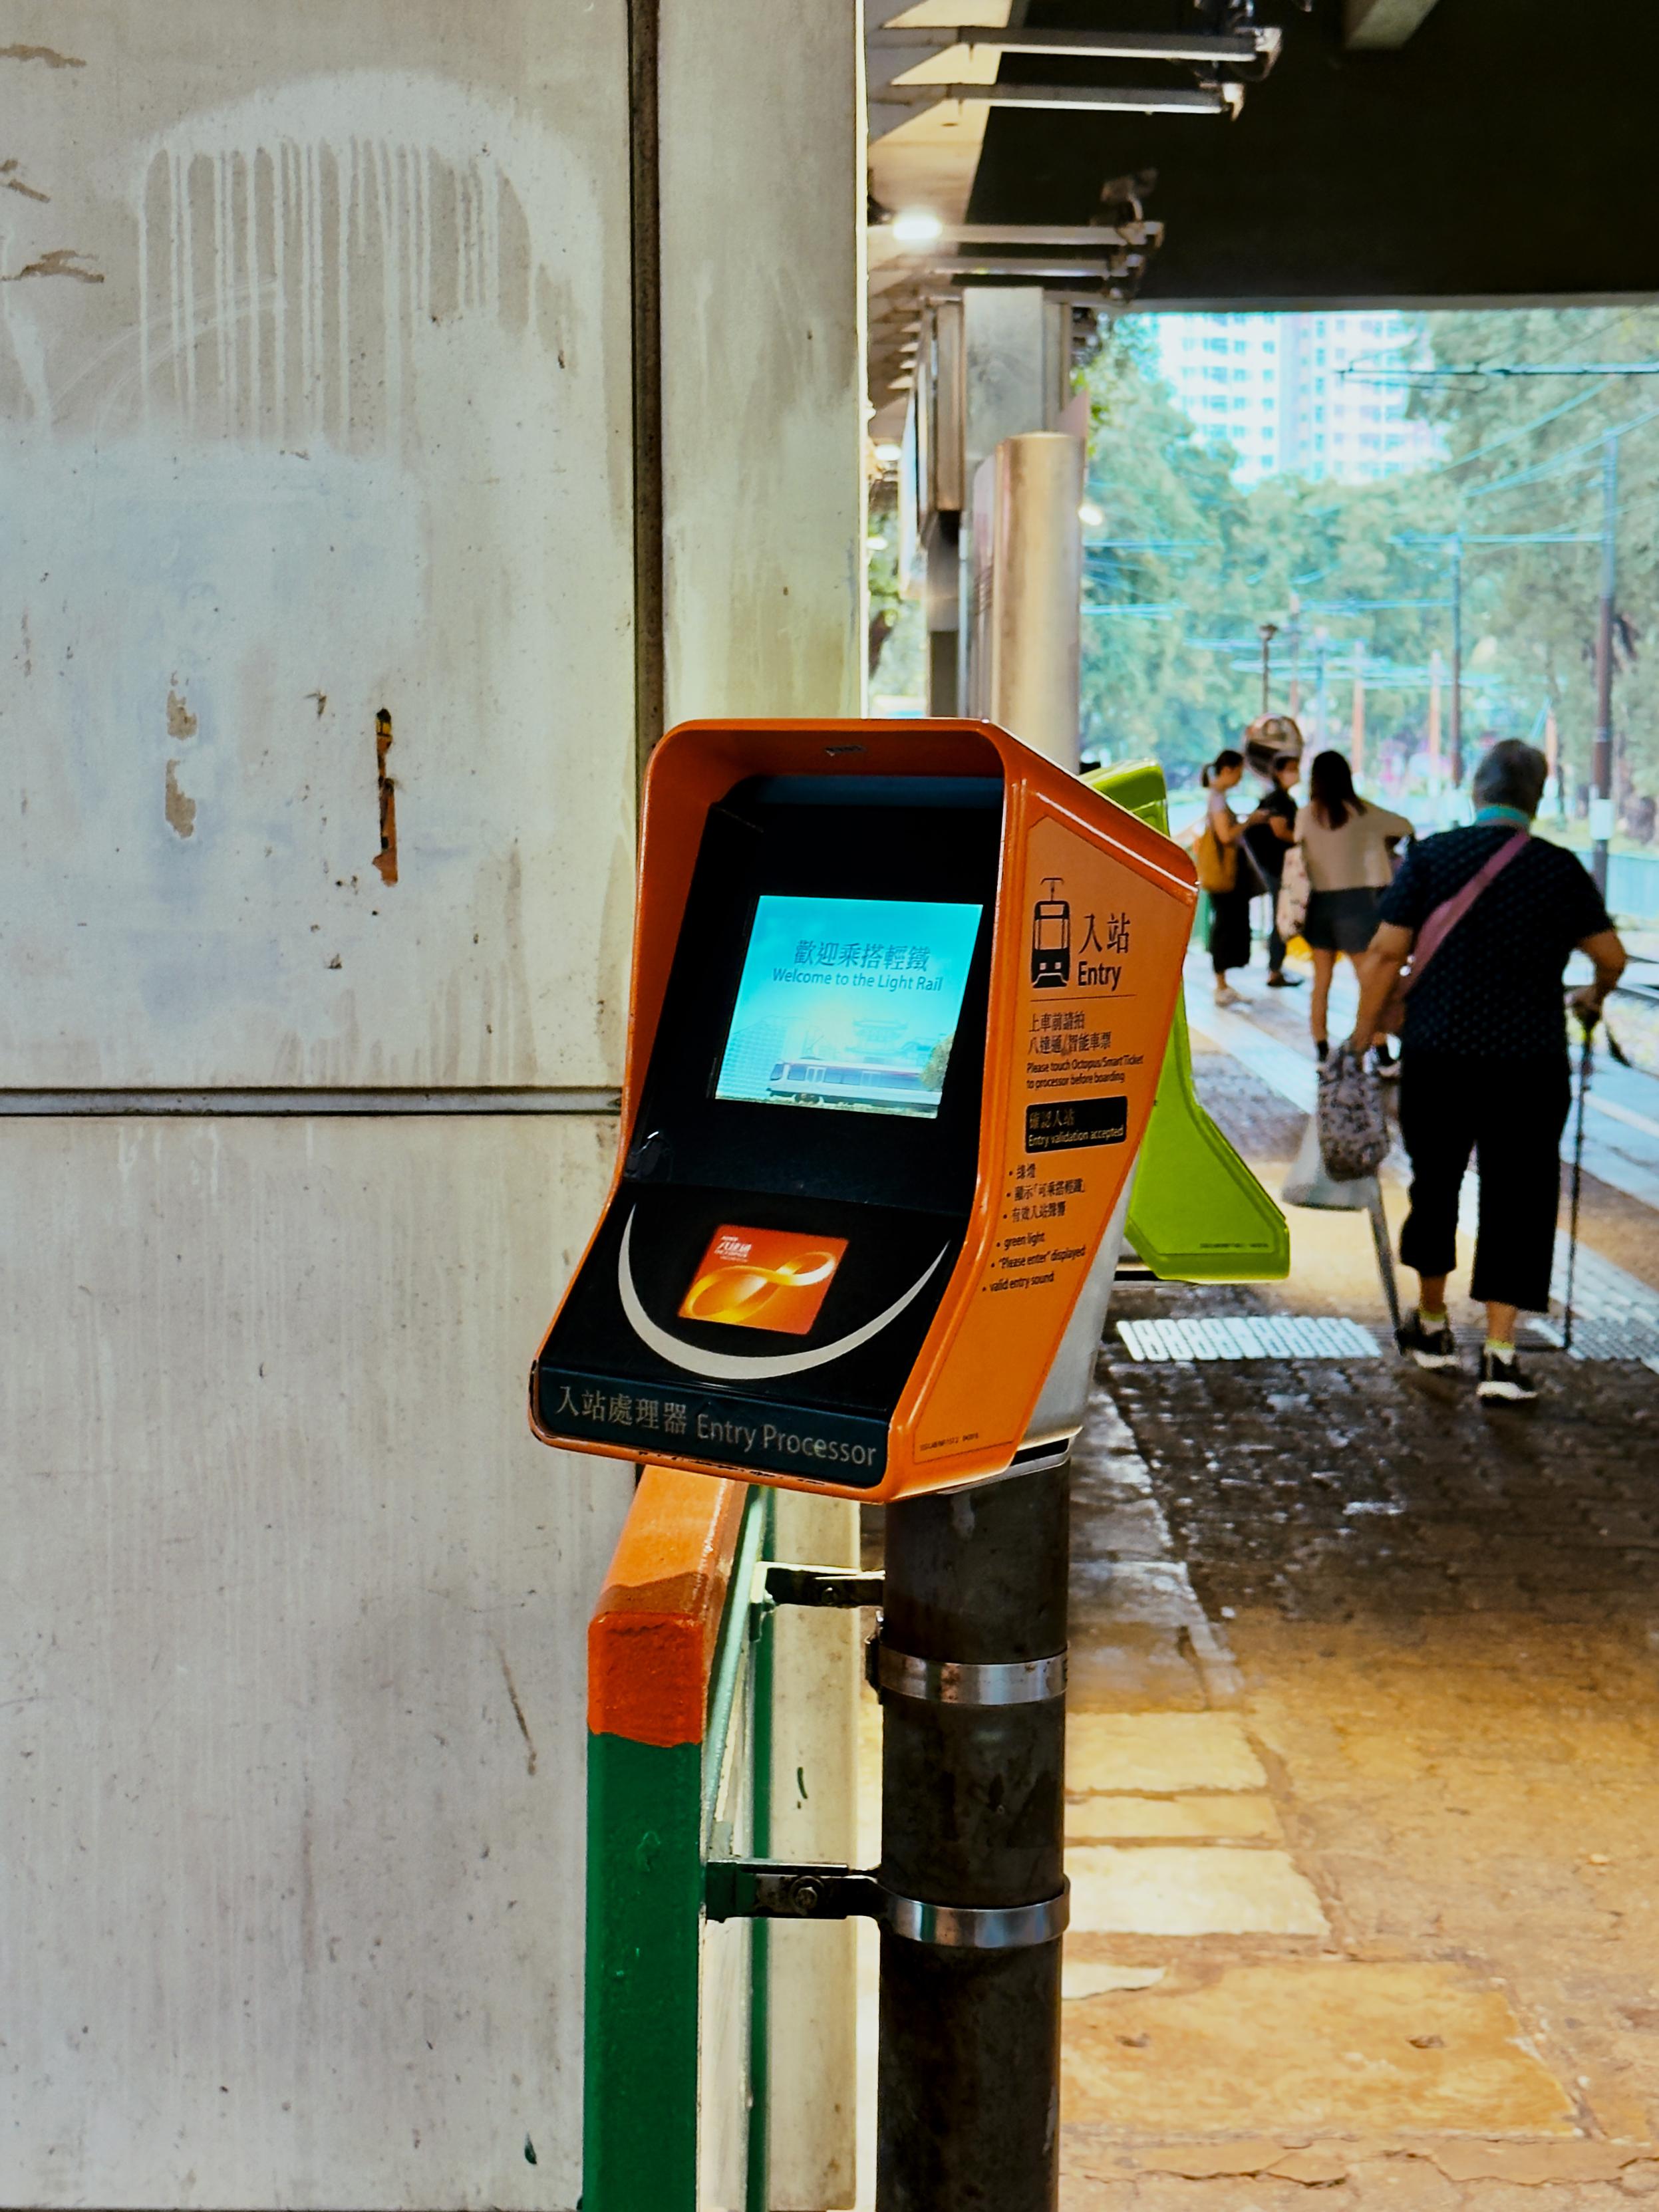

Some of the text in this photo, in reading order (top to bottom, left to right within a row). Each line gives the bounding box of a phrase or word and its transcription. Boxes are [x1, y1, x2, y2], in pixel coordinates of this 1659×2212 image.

[1078, 912, 1131, 954] 入站
[794, 940, 930, 972] 歡迎乘搭輕鐵
[772, 968, 943, 992] Welcome to the Light Rail
[1078, 961, 1122, 991] Entry
[1026, 1062, 1050, 1073] Please
[1050, 1061, 1070, 1071] touch
[1123, 1054, 1145, 1064] Ticket
[1026, 1071, 1125, 1091] to processor before boarding
[1028, 1125, 1124, 1148] Entry validation accepted
[1004, 1232, 1045, 1250] green light
[1050, 1244, 1086, 1262] displayed
[990, 1271, 1054, 1292] valid entry sound
[555, 1385, 688, 1435] 入站處理器
[696, 1413, 757, 1453] Entry
[763, 1424, 877, 1466] Processor
